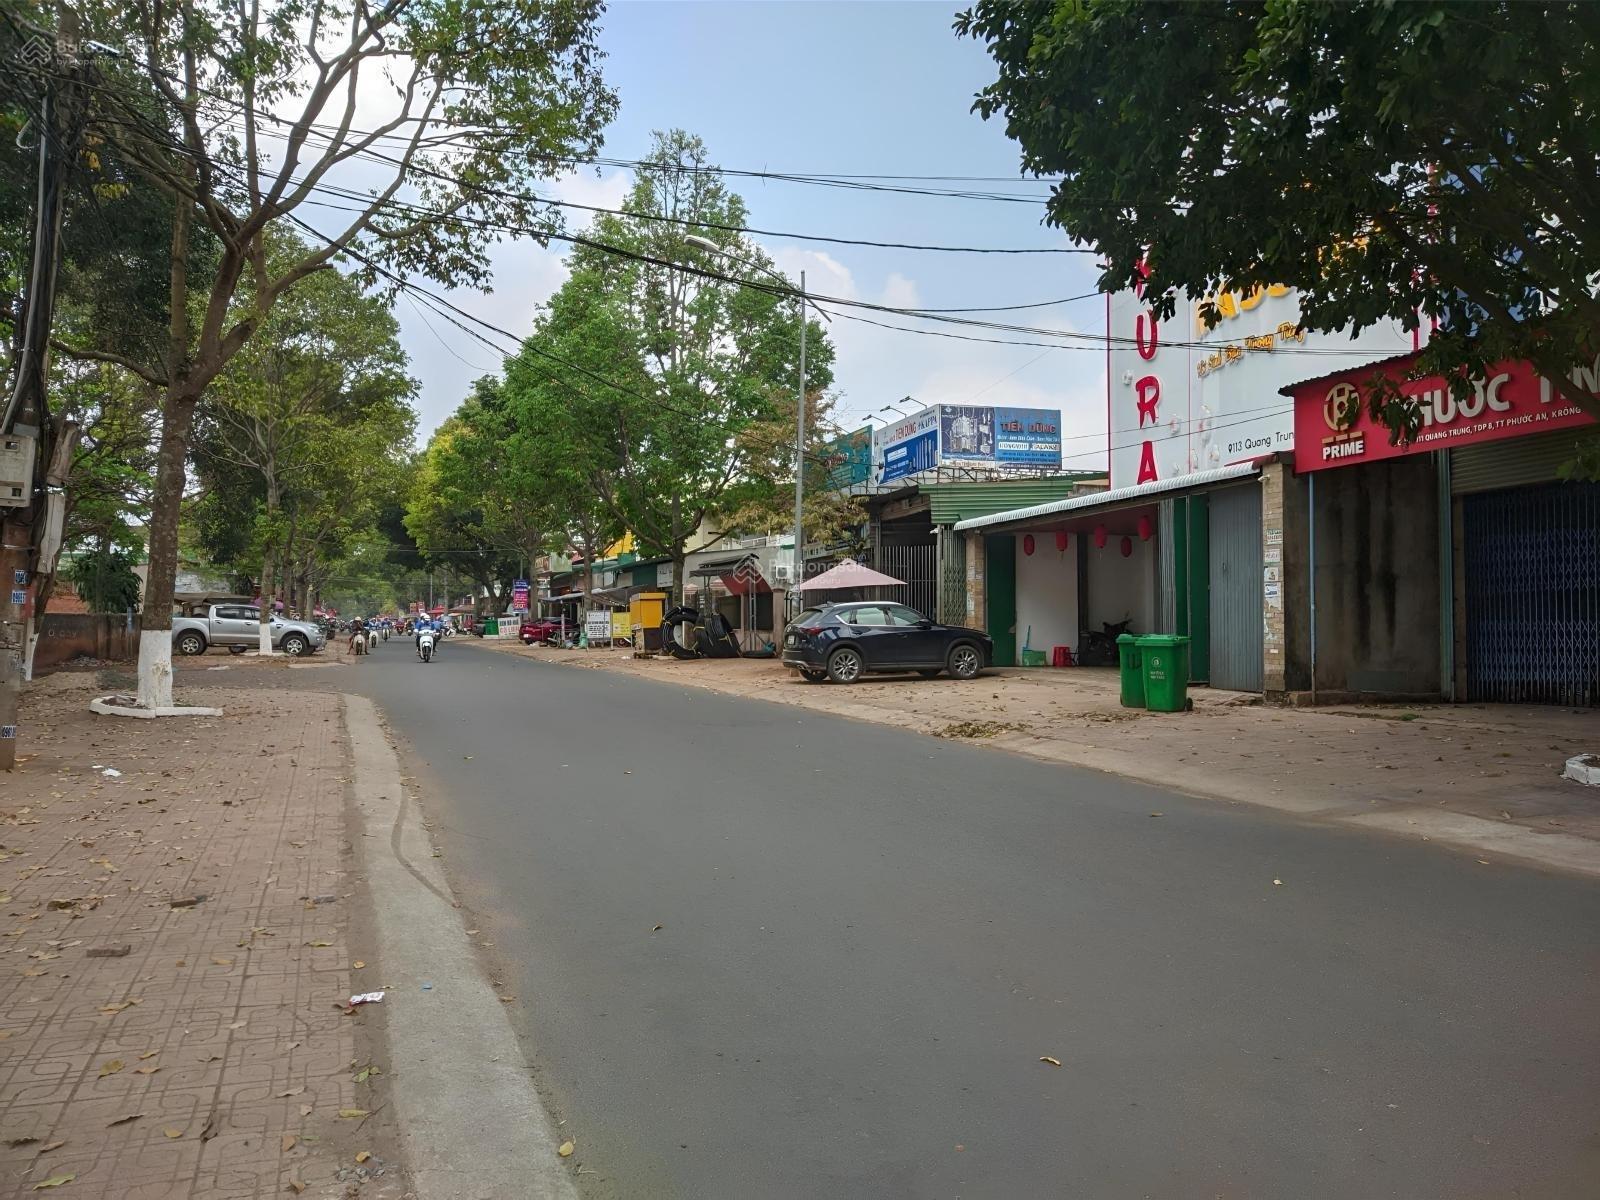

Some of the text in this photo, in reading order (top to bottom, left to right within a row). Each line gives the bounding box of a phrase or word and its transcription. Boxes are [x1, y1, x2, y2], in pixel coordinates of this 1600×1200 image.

[1425, 431, 1447, 441] QUANG
[1449, 426, 1472, 437] TRUNG,
[1507, 414, 1533, 426] PHƯỚC
[1535, 412, 1549, 421] AN,
[1245, 437, 1271, 450] Quang
[1322, 440, 1364, 460] PRIME
